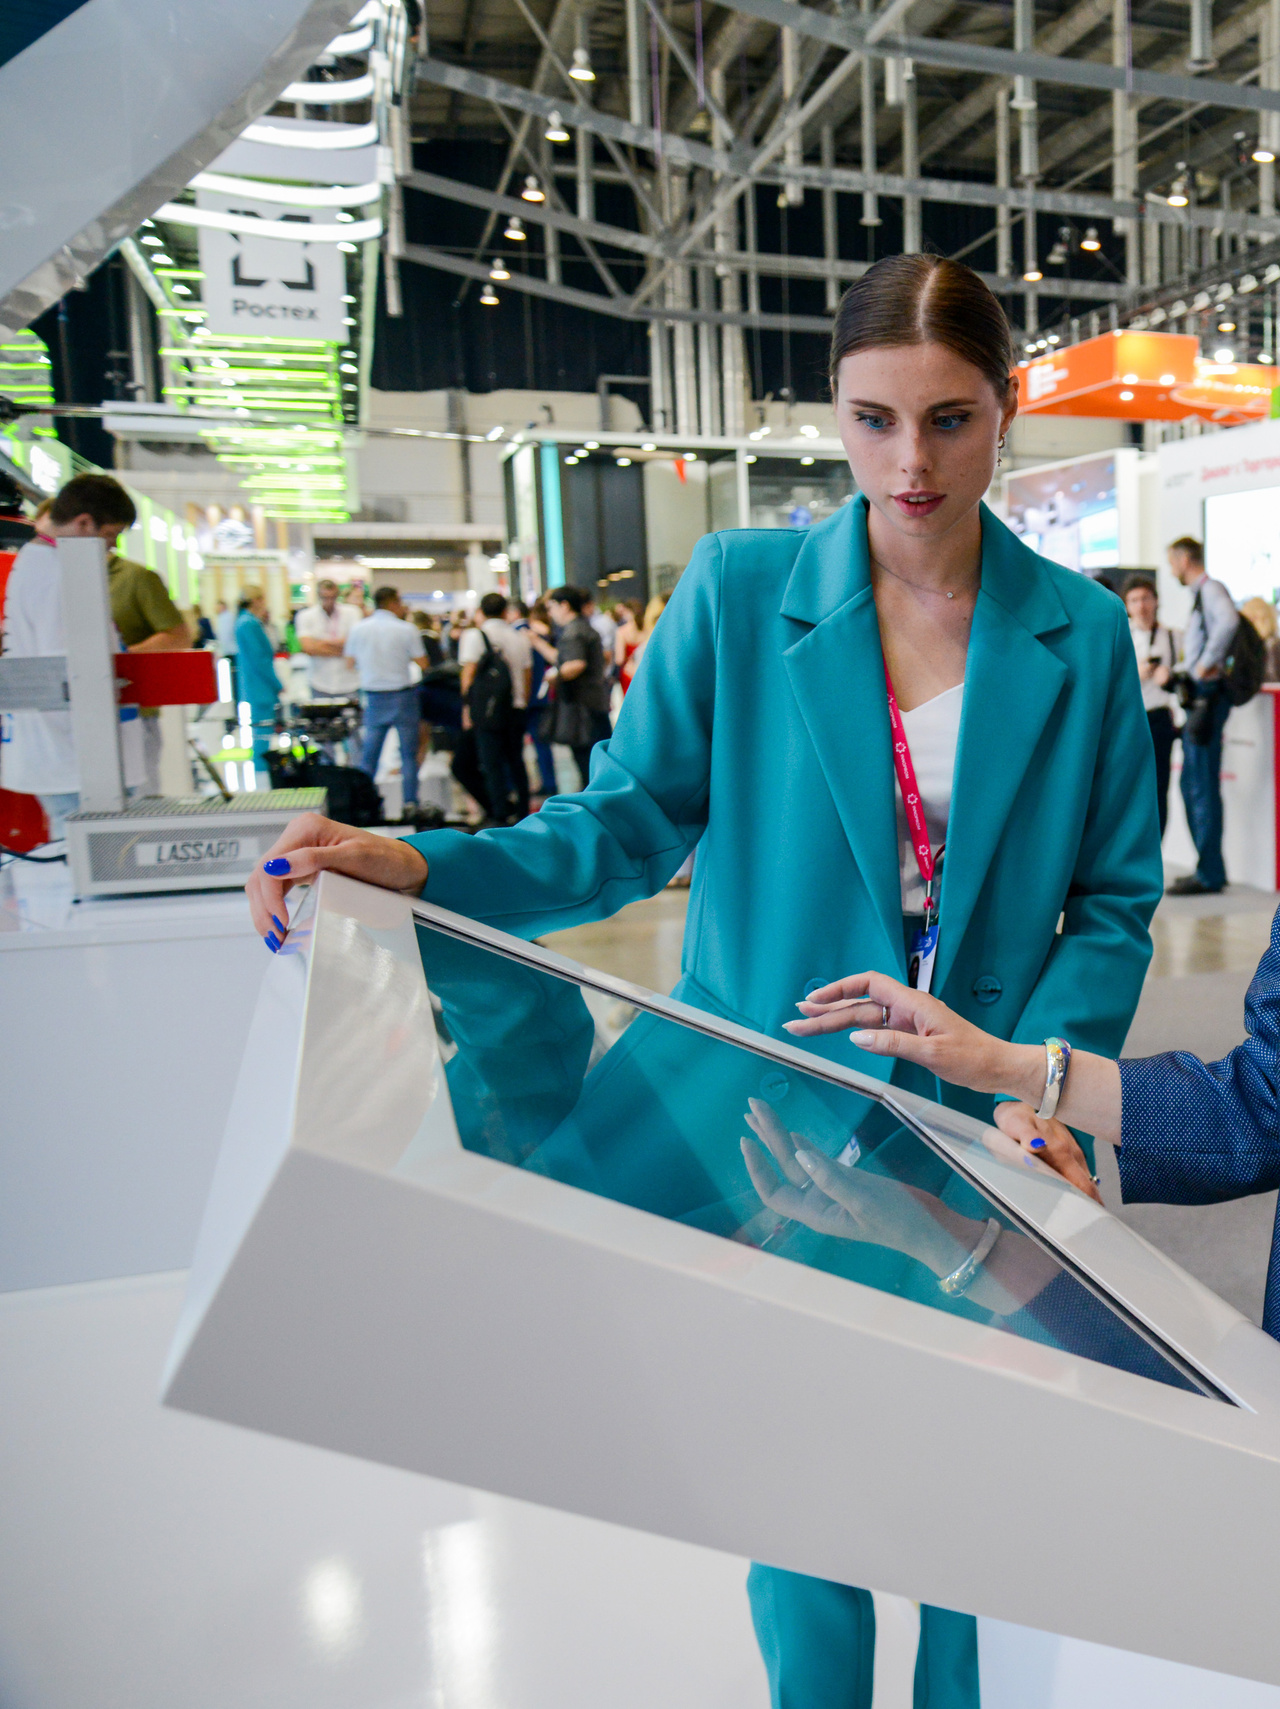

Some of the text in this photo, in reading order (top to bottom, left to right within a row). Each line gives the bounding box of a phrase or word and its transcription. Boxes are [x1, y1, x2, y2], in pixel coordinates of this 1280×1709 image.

[233, 299, 319, 320] Ростех
[900, 753, 910, 779] INNOPROM
[912, 805, 922, 830] INNOPROM
[157, 840, 239, 863] LASSARD
